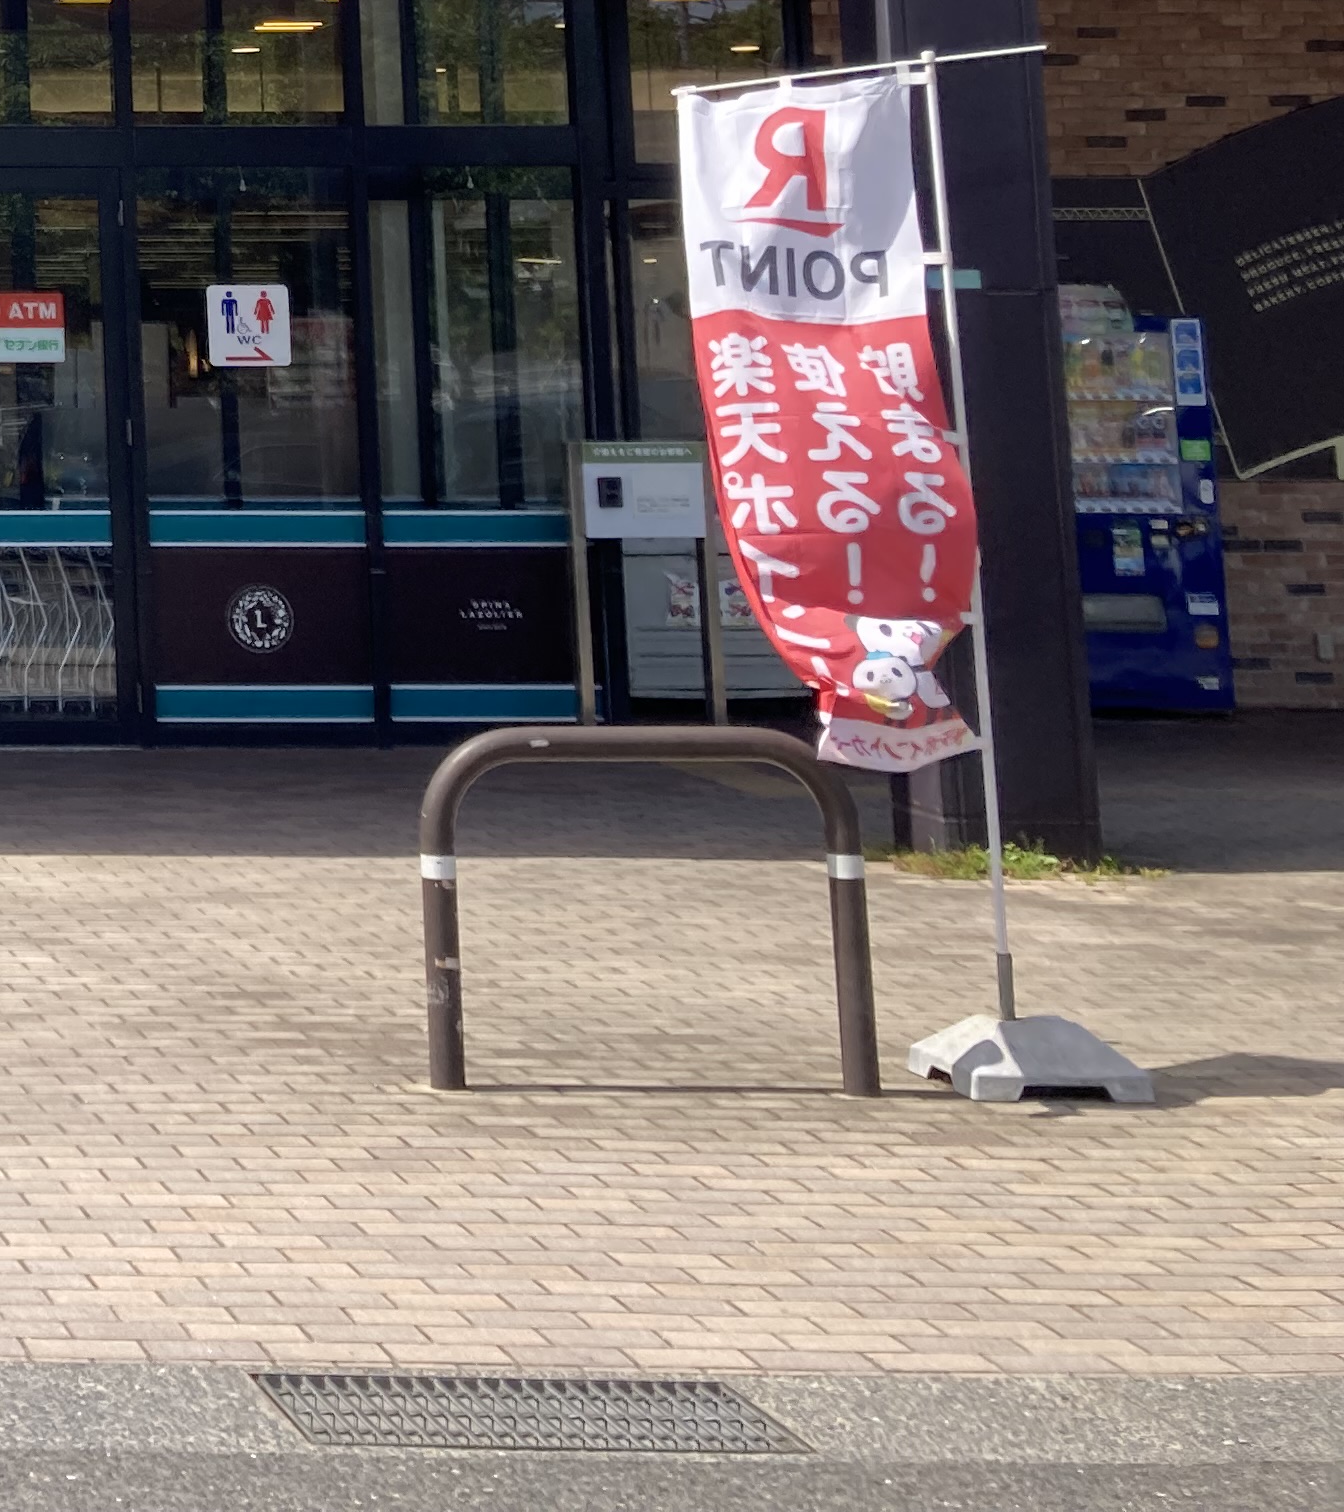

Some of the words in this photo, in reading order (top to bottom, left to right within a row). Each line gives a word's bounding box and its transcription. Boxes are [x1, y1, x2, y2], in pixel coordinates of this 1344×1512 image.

[8, 302, 57, 321] ATM
[236, 336, 262, 345] WC
[254, 609, 268, 628] L
